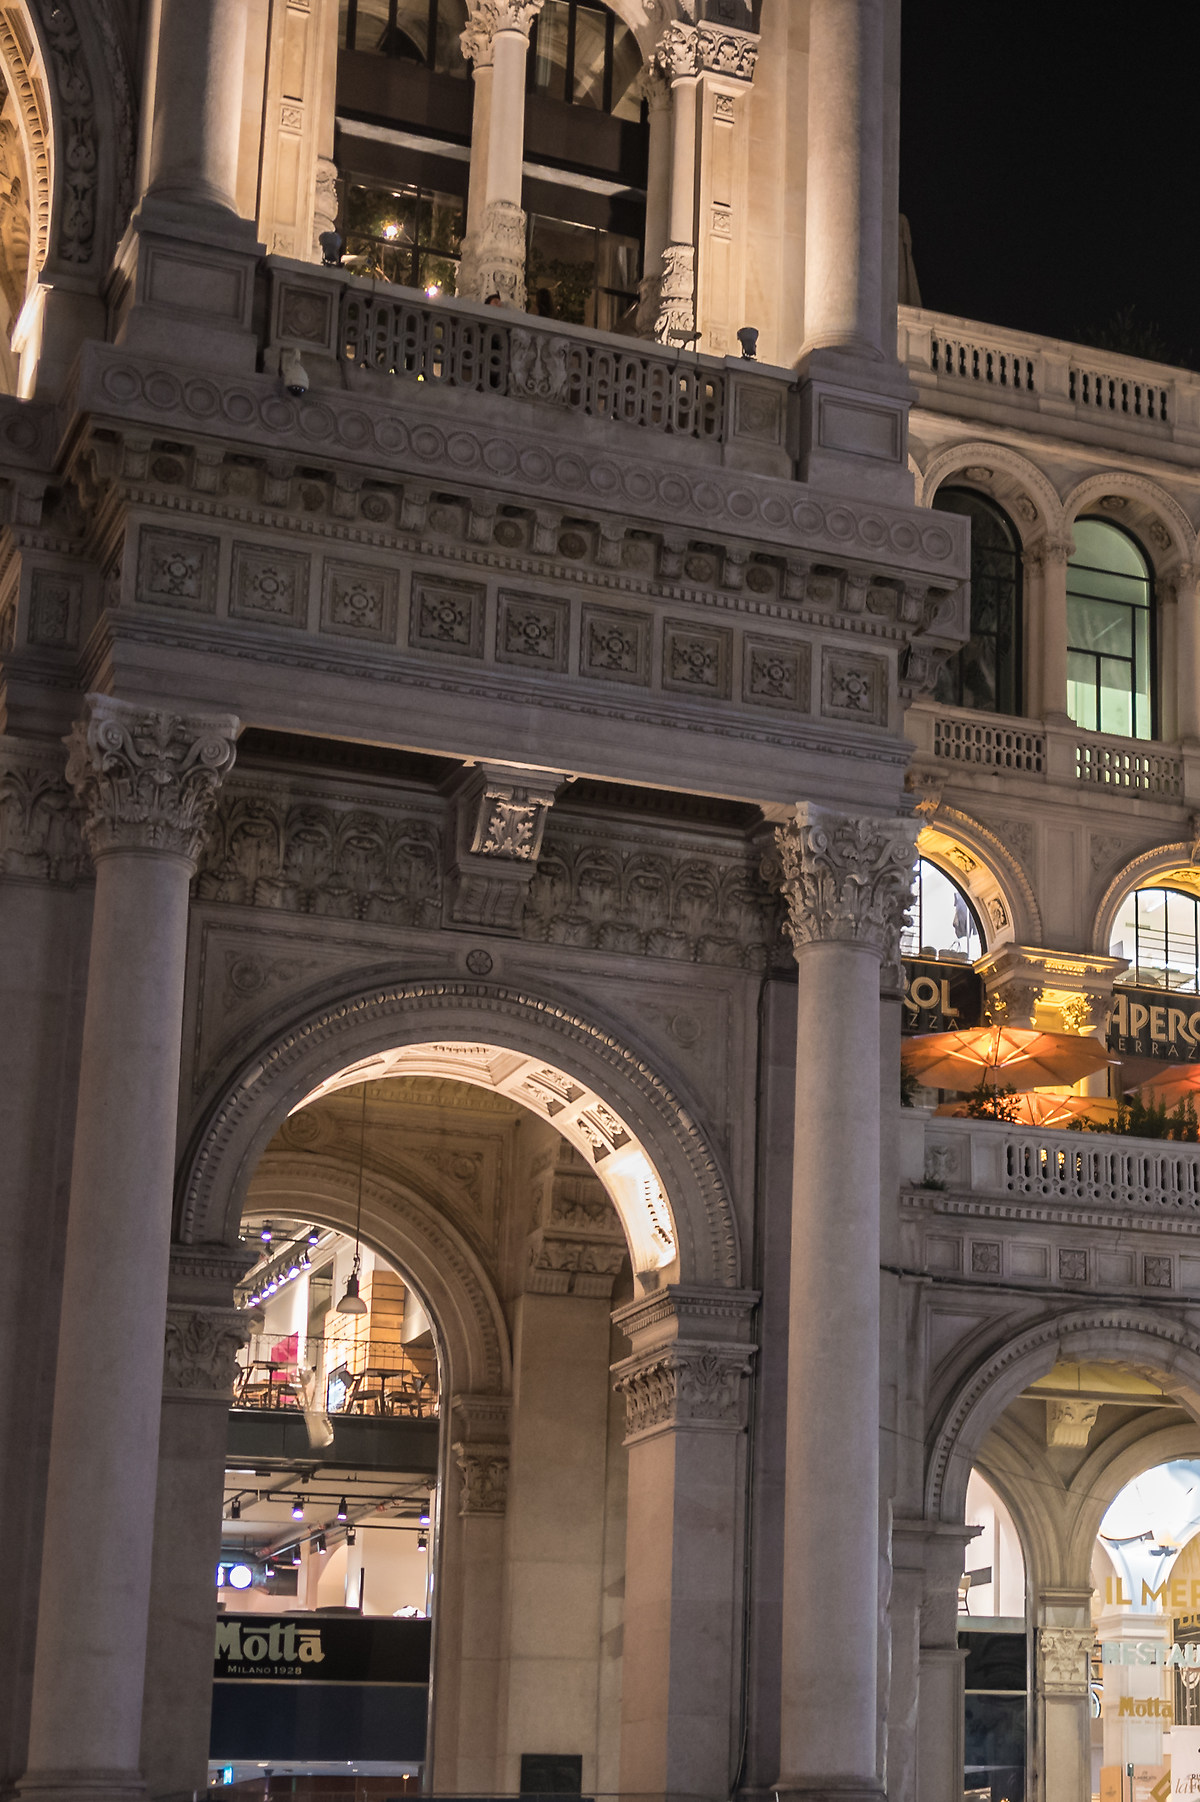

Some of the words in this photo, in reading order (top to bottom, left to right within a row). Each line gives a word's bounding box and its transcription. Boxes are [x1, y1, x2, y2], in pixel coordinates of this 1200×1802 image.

[1105, 1577, 1132, 1605] IL
[215, 1621, 326, 1663] Motta
[227, 1664, 271, 1675] MILANO
[274, 1666, 302, 1675] 1928
[1118, 1696, 1174, 1718] Motta
